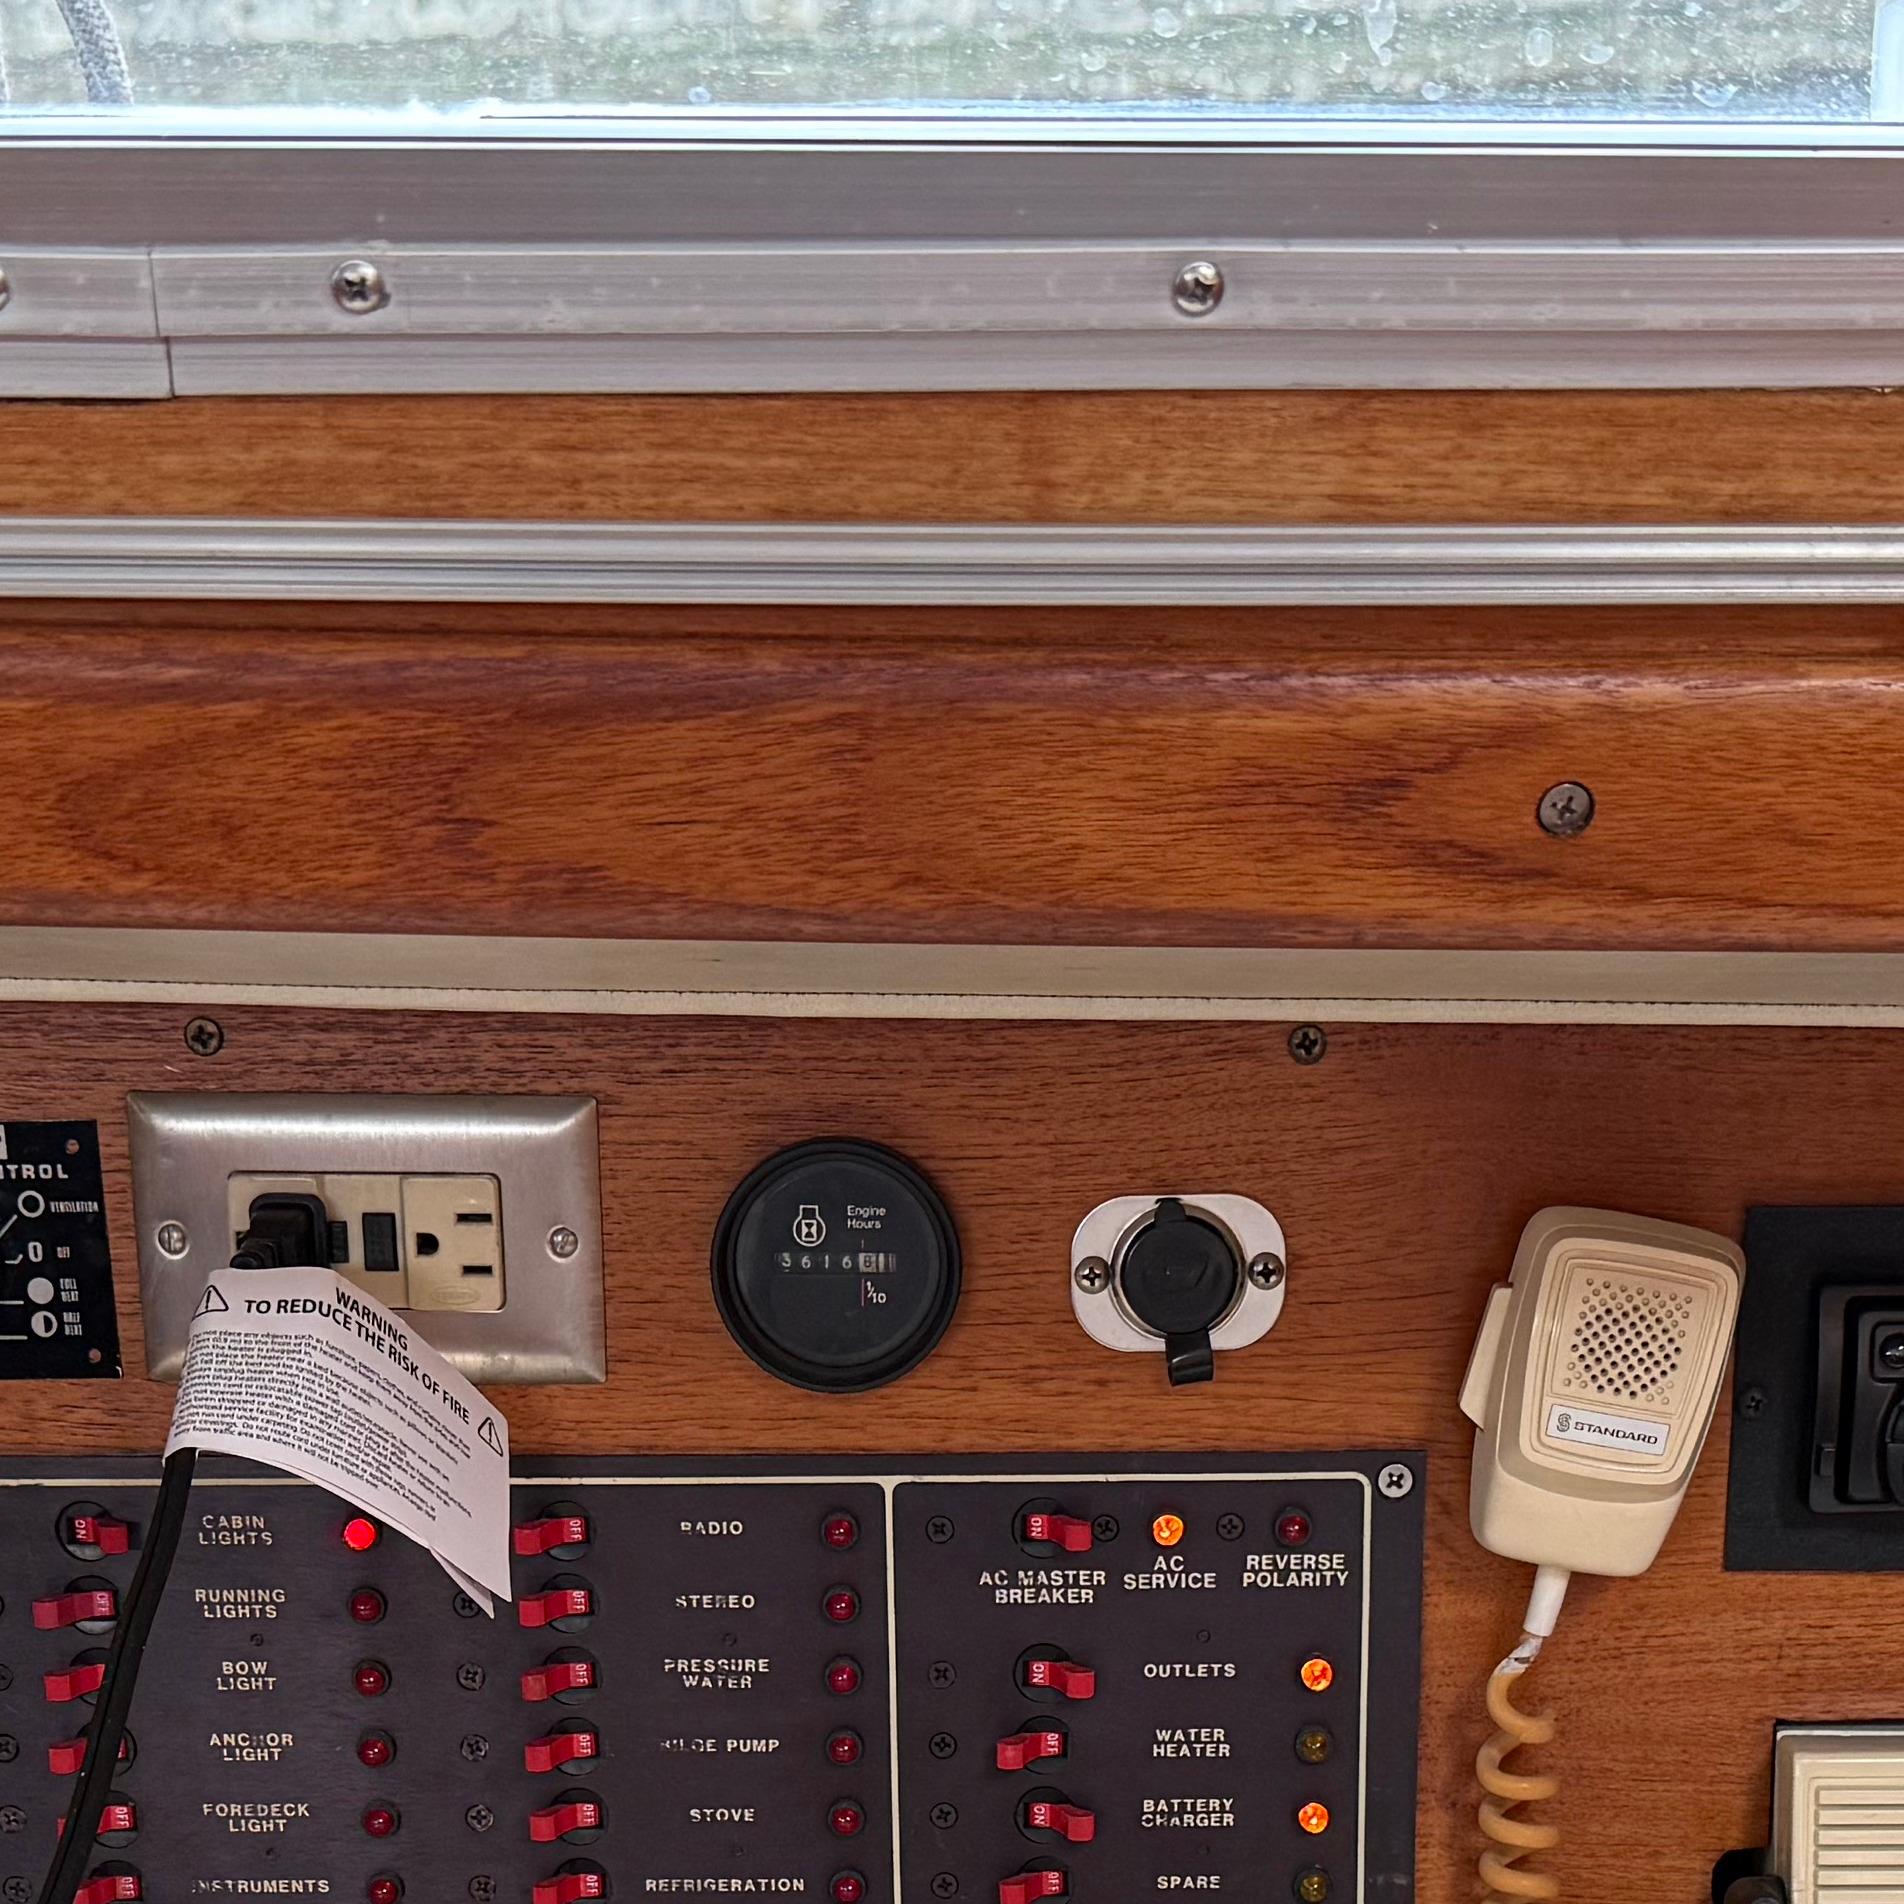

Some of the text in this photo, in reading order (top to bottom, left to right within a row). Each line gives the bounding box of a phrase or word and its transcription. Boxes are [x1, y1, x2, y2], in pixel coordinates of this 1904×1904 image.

[847, 1205, 886, 1218] Engine
[848, 1219, 881, 1228] Hours
[336, 1288, 408, 1351] WARNING
[245, 1299, 271, 1314] TO
[276, 1299, 351, 1331] REDUCE
[355, 1321, 385, 1354] THE
[388, 1343, 419, 1381] RISK
[422, 1373, 440, 1395] OF
[442, 1389, 470, 1425] FIRE
[1574, 1421, 1658, 1446] STANDARD
[203, 1515, 264, 1528] CABIN
[681, 1521, 742, 1534] RADIO
[569, 1519, 583, 1541] OFF
[199, 1532, 272, 1545] LIGHTS
[1154, 1556, 1184, 1571] AC
[1247, 1554, 1344, 1570] REVERSE
[980, 1570, 1105, 1585] AC MASTER
[1124, 1573, 1216, 1589] SERVICE
[1243, 1571, 1348, 1587] POLARITY
[195, 1589, 285, 1602] RUNNING
[573, 1591, 586, 1613] OFF
[676, 1595, 754, 1608] STEREO
[996, 1588, 1093, 1603] BREAKER
[204, 1605, 276, 1618] LIGHTS
[222, 1661, 267, 1674] BOW
[665, 1659, 769, 1672] PRESSURE
[1144, 1664, 1235, 1677] OUTLETS
[576, 1663, 588, 1685] OFF
[217, 1678, 276, 1690] LIGHT
[683, 1675, 751, 1688] WATER
[1156, 1729, 1224, 1741] WATER
[578, 1734, 591, 1757] OFF
[727, 1740, 779, 1752] PUMP
[1046, 1733, 1059, 1755] OFF
[1153, 1744, 1230, 1757] HEATER
[223, 1748, 281, 1760] LIGHT
[203, 1804, 309, 1816] FOREDECK
[1144, 1799, 1233, 1812] BATTERY
[115, 1806, 129, 1828] OFF
[582, 1804, 595, 1825] OFF
[690, 1809, 754, 1821] STOVE
[1142, 1814, 1234, 1827] CHARGER
[229, 1819, 286, 1832] LIGHT
[121, 1877, 135, 1899] OFF
[586, 1875, 599, 1896] OFF
[646, 1879, 803, 1891] REFRIGERATION
[1048, 1871, 1059, 1893] OFF
[1158, 1876, 1220, 1889] SPARE
